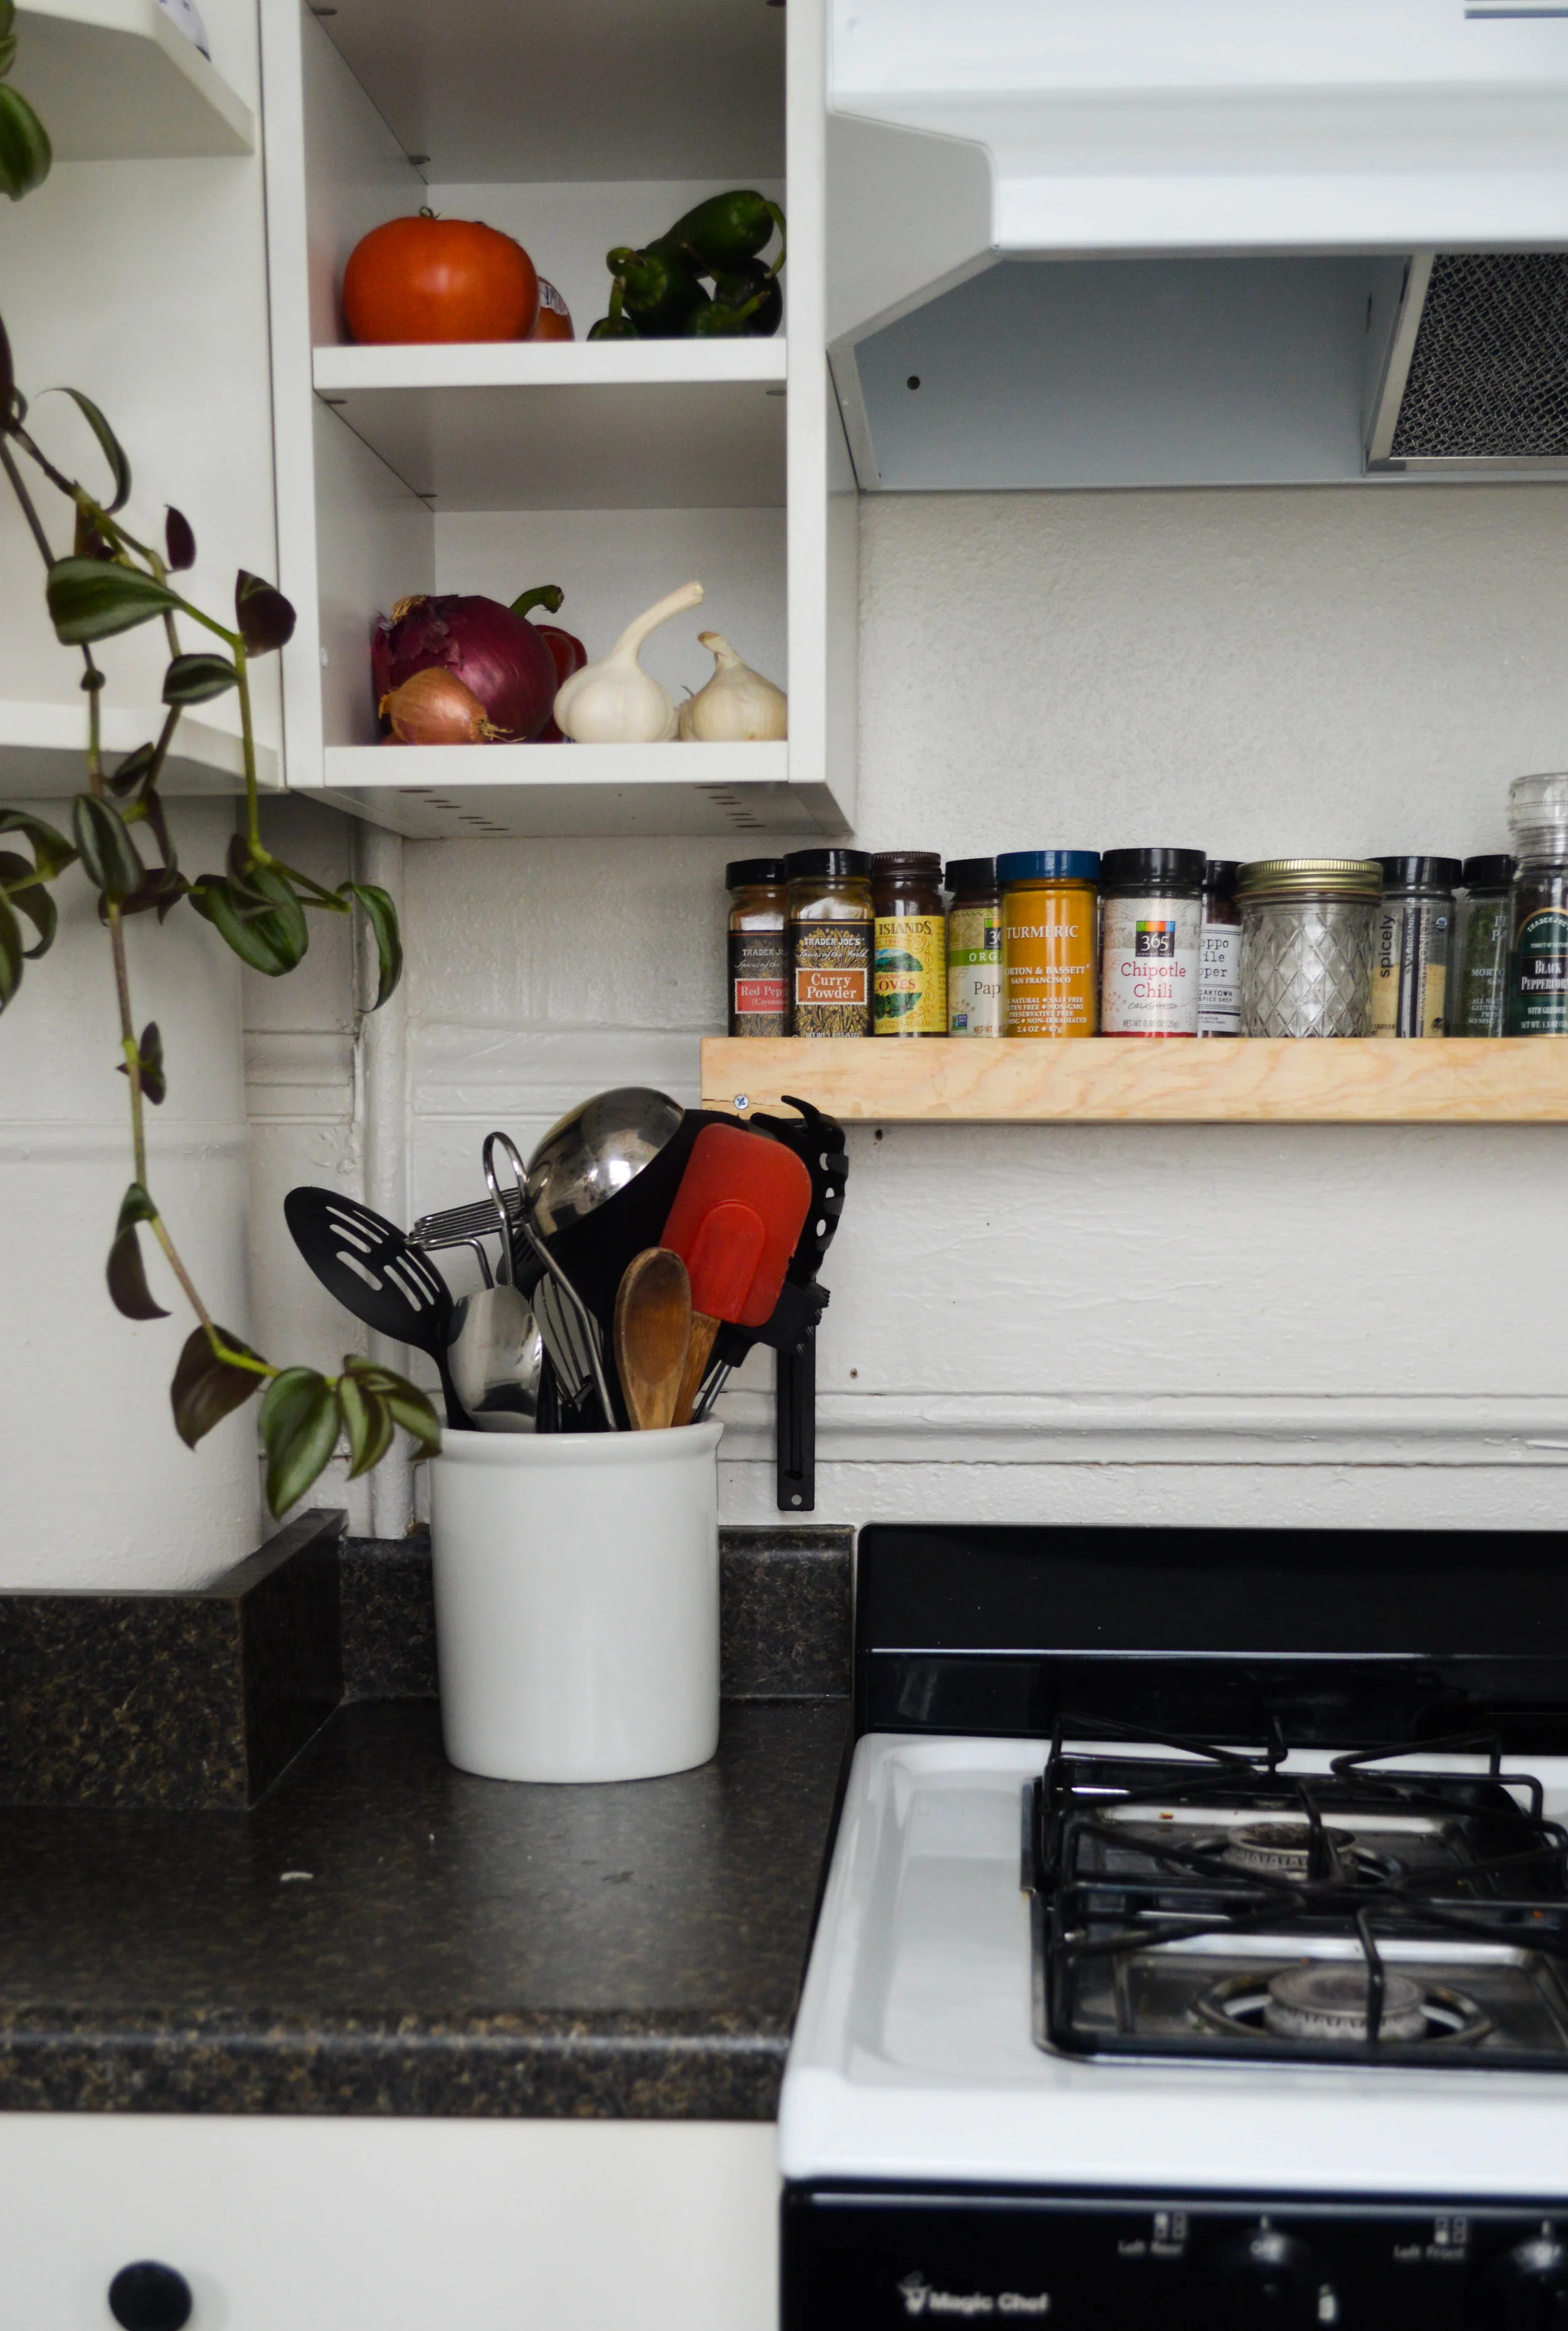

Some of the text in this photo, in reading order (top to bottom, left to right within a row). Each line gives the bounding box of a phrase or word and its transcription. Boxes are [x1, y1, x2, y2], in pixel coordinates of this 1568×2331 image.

[878, 920, 932, 935] ISLANDS
[1527, 917, 1553, 932] TRADER
[1007, 926, 1079, 939] TURMERIC
[804, 938, 861, 946] TRADER JOE'S
[1140, 933, 1170, 952] 365
[1379, 915, 1395, 978] spicely
[796, 949, 821, 960] Spices
[830, 949, 844, 958] the
[1199, 951, 1225, 962] ile
[1005, 966, 1085, 975] ORTON & BASSETT
[1121, 961, 1186, 979] Chipotle
[1535, 960, 1562, 974] BLACK
[810, 973, 851, 988] Curry
[874, 978, 916, 992] OVES
[741, 985, 760, 996] Red
[807, 986, 857, 999] Powder
[1134, 983, 1173, 998] Chili
[1128, 1002, 1177, 1010] CRUSHED
[1123, 1019, 1133, 1027] NET
[1133, 1019, 1142, 1027] WT
[1157, 1019, 1165, 1027] OZ
